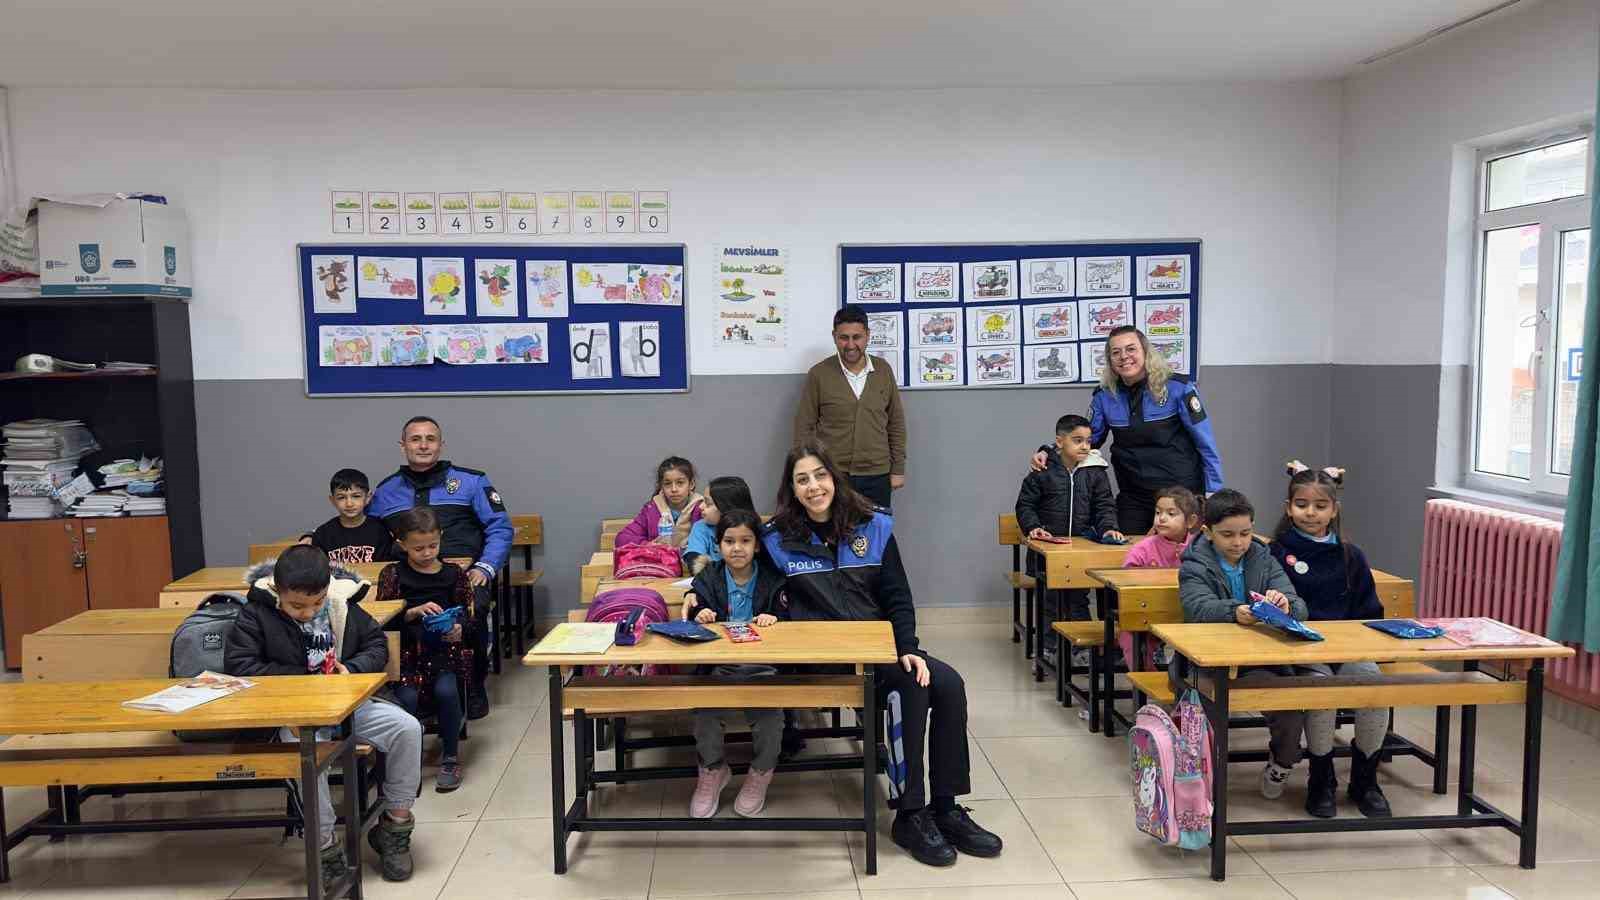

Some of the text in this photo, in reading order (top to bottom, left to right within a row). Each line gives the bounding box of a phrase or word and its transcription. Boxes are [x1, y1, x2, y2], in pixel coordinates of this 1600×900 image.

[346, 217, 351, 229] 1
[380, 217, 390, 229] 2
[417, 217, 426, 229] 3
[452, 217, 462, 230] 4
[484, 216, 494, 229] 5
[518, 217, 527, 230] 6
[551, 216, 560, 229] 7
[584, 216, 592, 228] 8
[616, 216, 625, 228] 9
[649, 216, 658, 228] 0
[723, 245, 779, 257] MEVSİMLER
[573, 329, 594, 364] d
[639, 325, 657, 358] b
